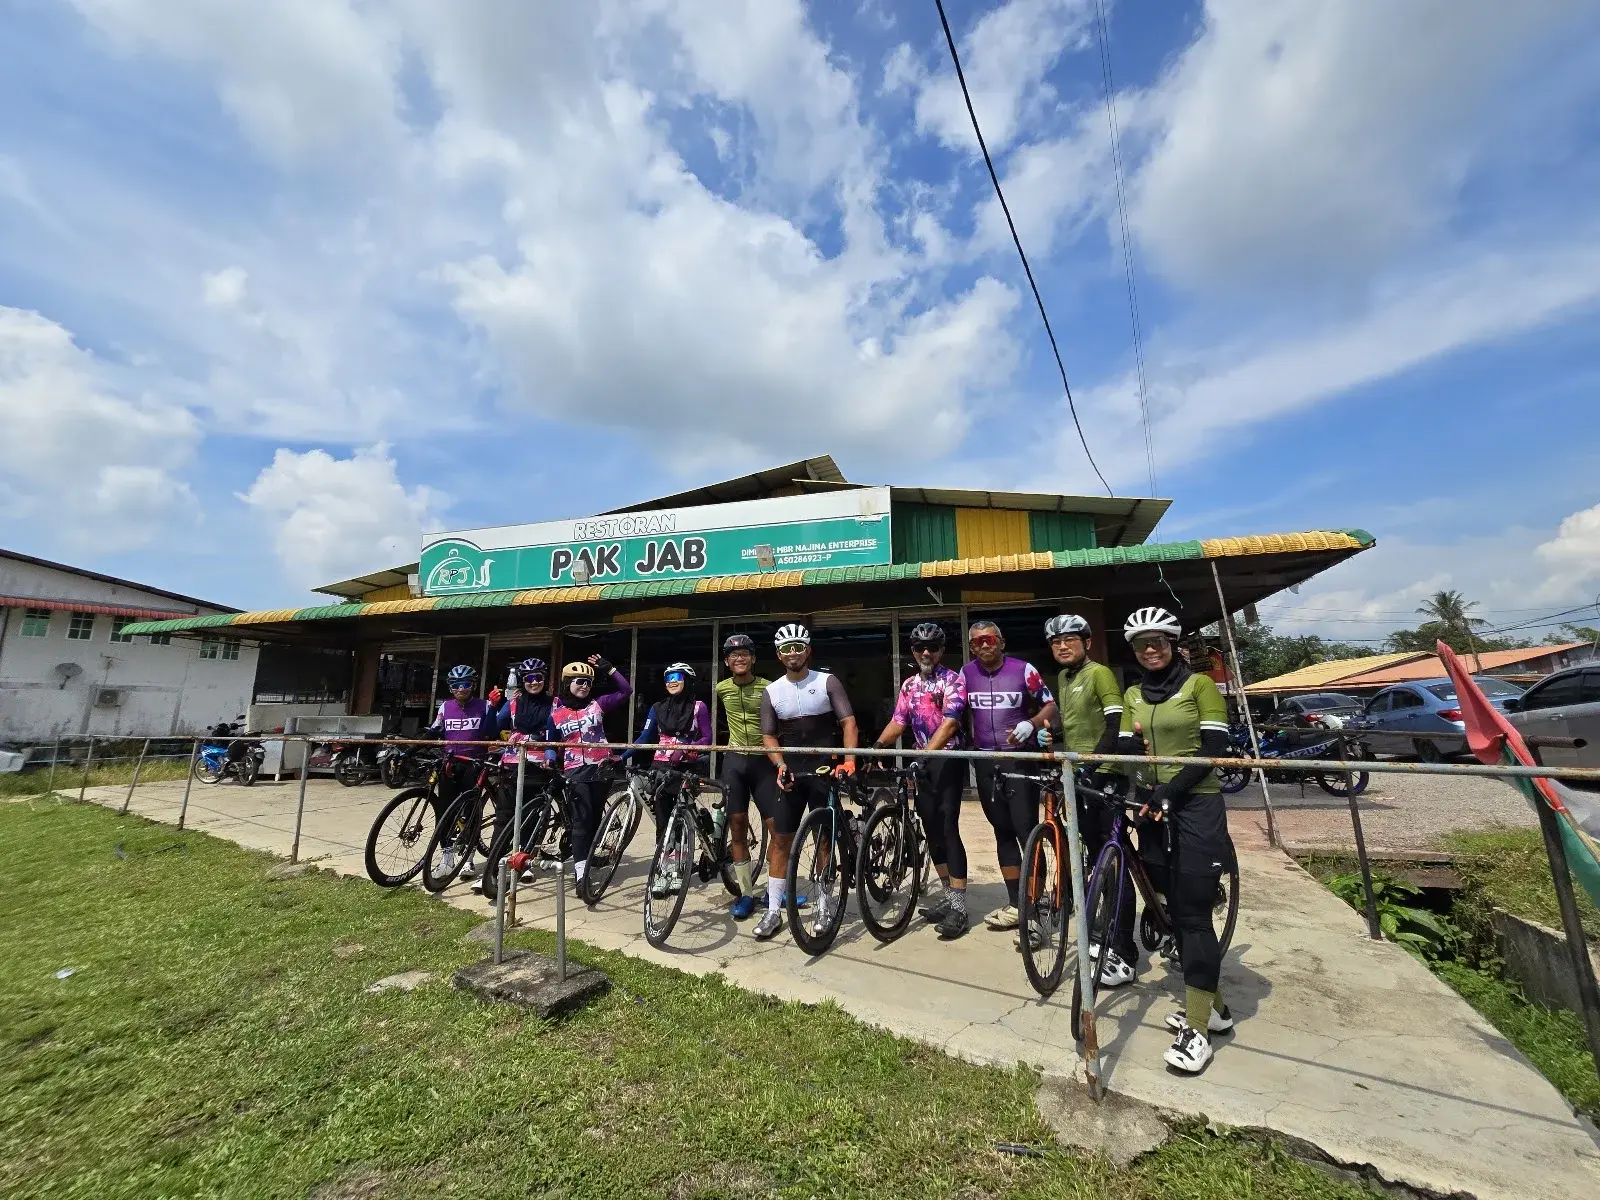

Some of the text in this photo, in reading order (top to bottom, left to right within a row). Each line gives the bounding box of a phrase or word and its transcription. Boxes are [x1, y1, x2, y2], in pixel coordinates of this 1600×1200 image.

[573, 514, 676, 540] RESTORAN
[550, 537, 707, 580] PAK JAB
[776, 545, 793, 554] MBR
[795, 542, 827, 552] NAJINA
[828, 539, 877, 550] ENTERPRISE
